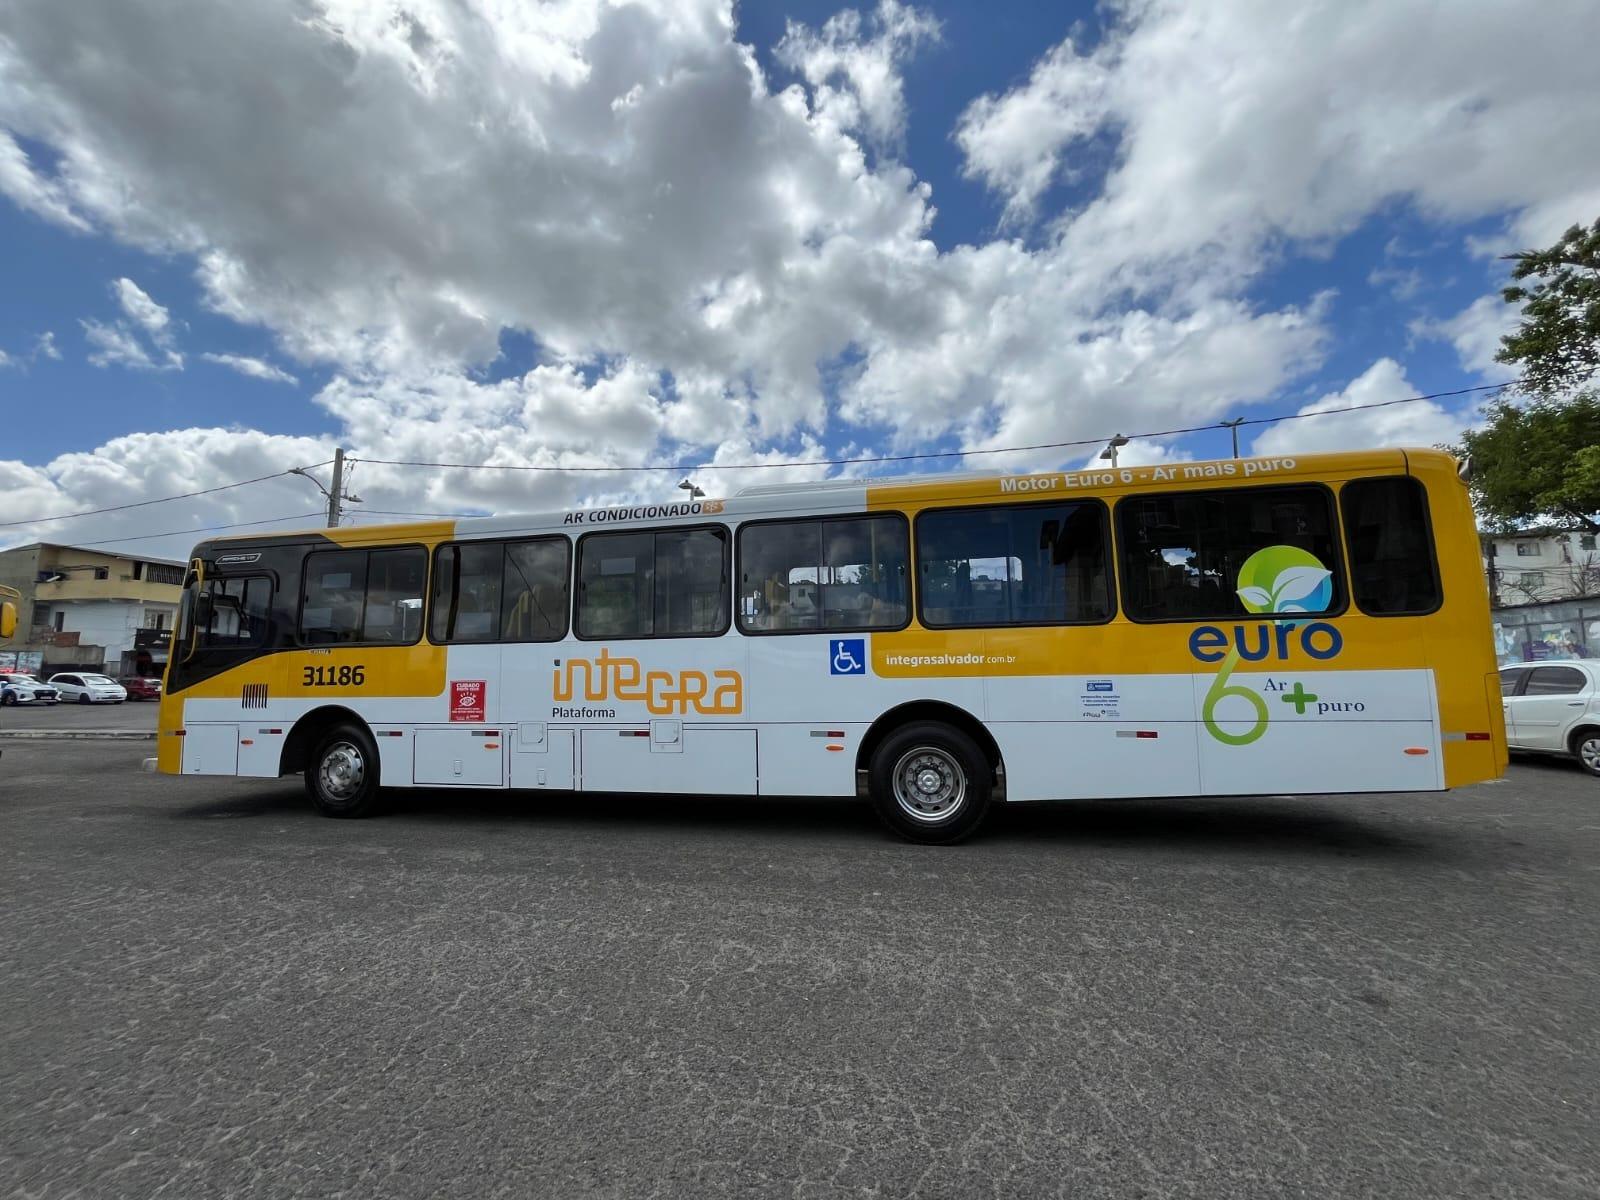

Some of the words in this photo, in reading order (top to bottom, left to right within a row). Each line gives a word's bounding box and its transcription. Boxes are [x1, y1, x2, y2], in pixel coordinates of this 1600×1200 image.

[1000, 476, 1058, 492] Motor
[1065, 472, 1114, 488] Euro
[1120, 470, 1132, 483] 6
[1153, 467, 1177, 481] Ar
[1184, 462, 1236, 478] mais
[1244, 458, 1297, 477] puro
[564, 512, 584, 525] AR
[589, 503, 702, 522] CONDICIONADO
[1189, 622, 1343, 662] euro
[886, 653, 1016, 667] integrasalvador.com.br
[303, 665, 365, 686] 31186
[1264, 678, 1288, 691] Ar
[1202, 645, 1269, 746] 6
[552, 707, 616, 718] Plataforma
[1318, 702, 1365, 715] puro
